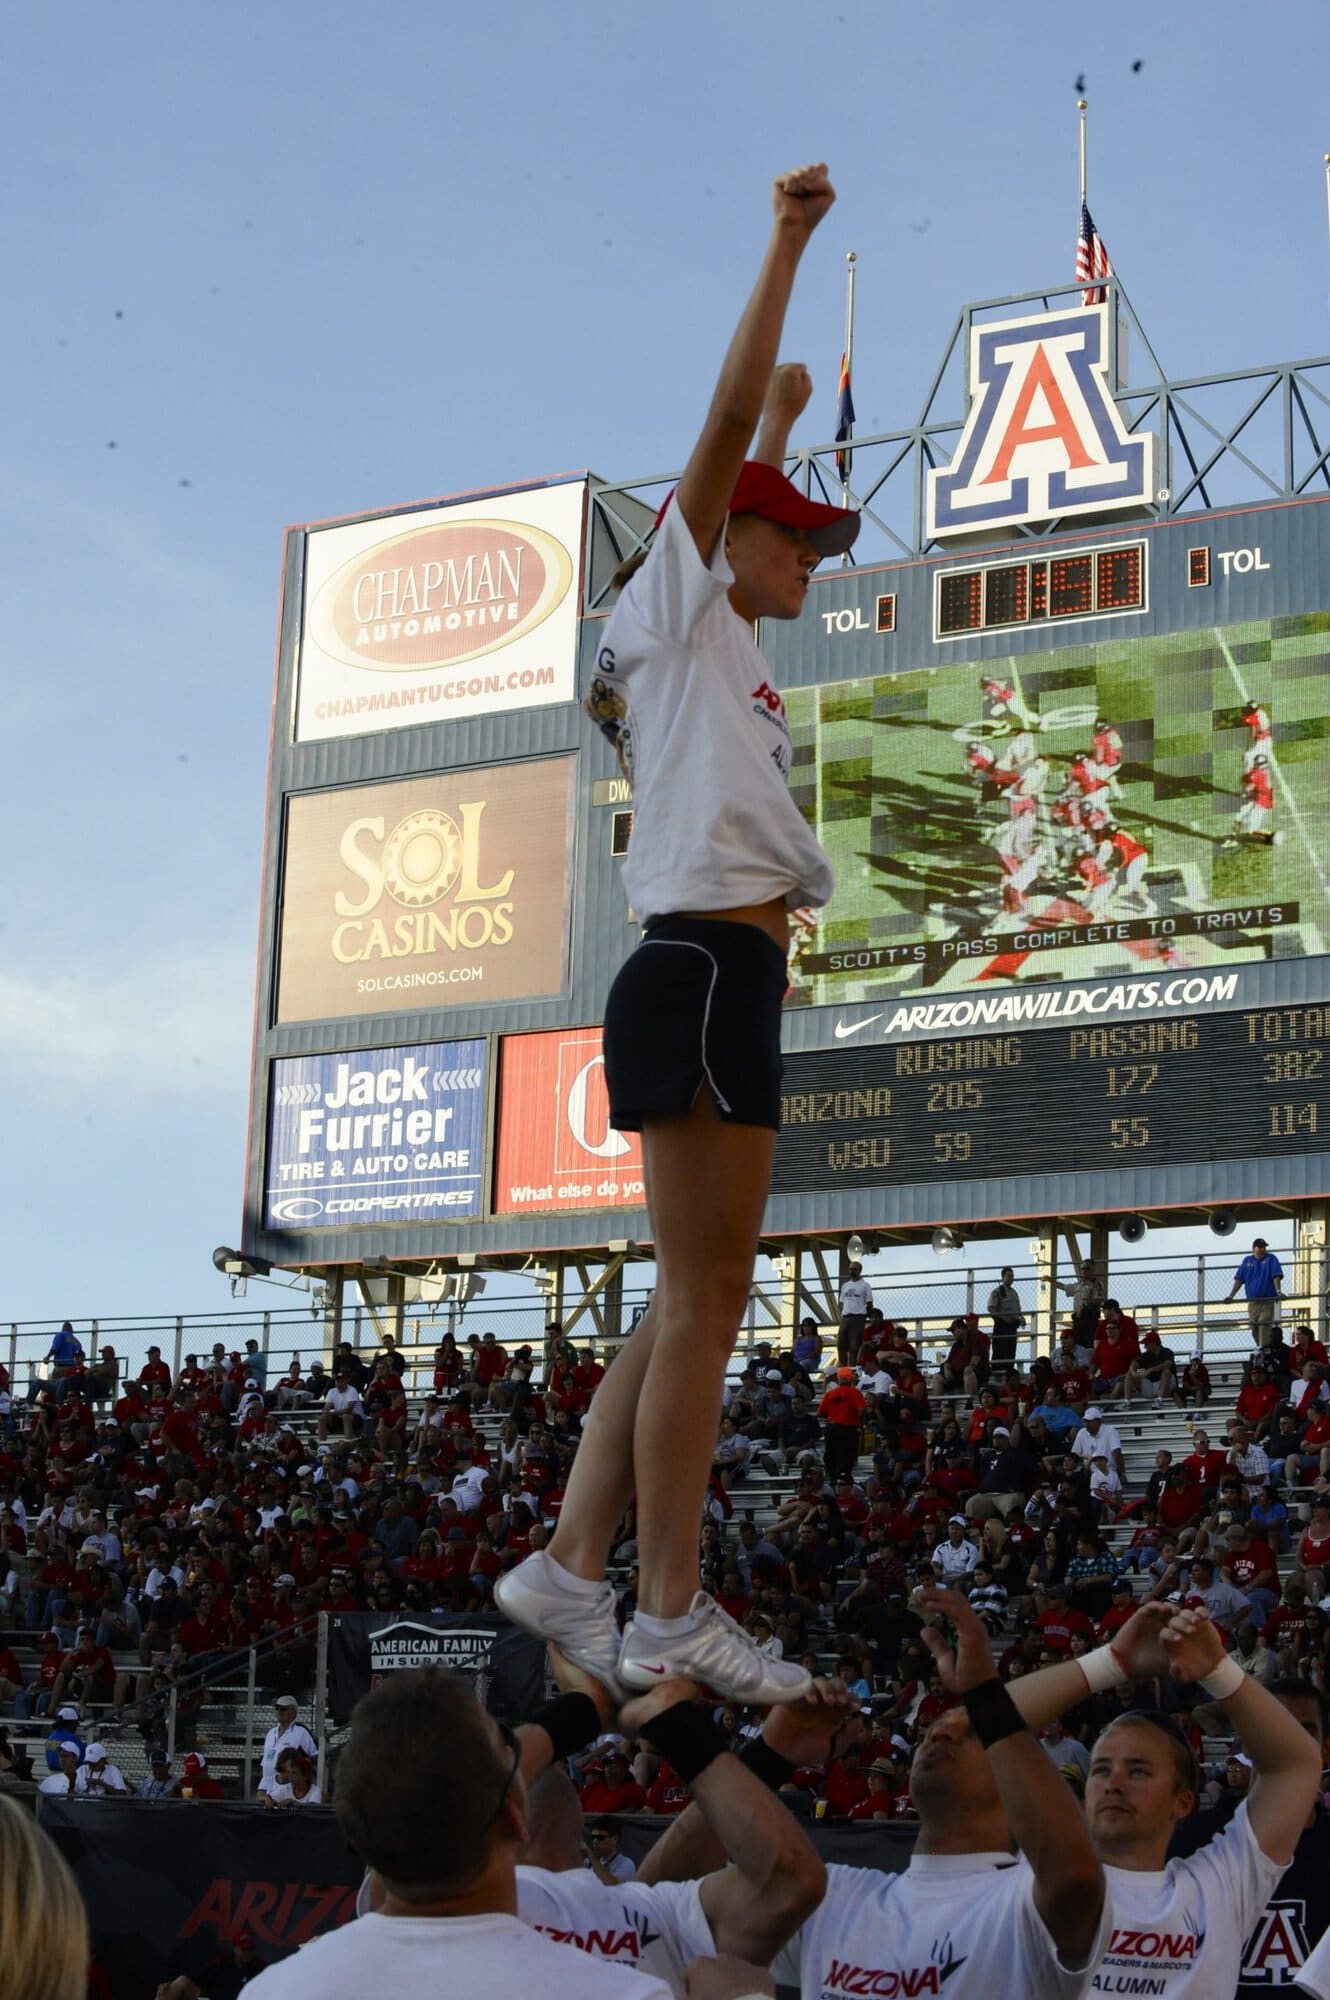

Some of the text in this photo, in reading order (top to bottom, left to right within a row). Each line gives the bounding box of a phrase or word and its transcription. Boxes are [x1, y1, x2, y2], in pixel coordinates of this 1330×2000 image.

[353, 547, 525, 624] CHAPMAN
[1217, 547, 1271, 575] TOL
[356, 602, 519, 646] AUTOMOTIVE
[822, 609, 869, 634] TOL
[315, 667, 555, 720] CHAPMANTUCSON.COM
[335, 801, 515, 917] SOL
[332, 901, 514, 964] CASINOS
[829, 906, 1283, 970] SCOTT'S PASS COMPLETE TO TRAVIS
[357, 966, 483, 993] SOLCASINOS.COM
[884, 974, 1239, 1034] ARIZONAWILDCATS.COM
[895, 1036, 1023, 1076] RUSHING
[1070, 1020, 1199, 1060] PASSING
[324, 1057, 430, 1109] Jack
[927, 1079, 984, 1112] 205
[1106, 1064, 1159, 1098] 177
[1263, 1049, 1323, 1082] 382
[299, 1103, 454, 1154] Furrier
[828, 1138, 890, 1170] WSU
[934, 1131, 972, 1162] 59
[1111, 1116, 1149, 1149] 55
[280, 1149, 469, 1181] TIRE & AUTO CARE
[510, 1185, 552, 1203] What
[558, 1182, 592, 1199] else
[597, 1180, 618, 1196] do
[371, 1639, 493, 1654] AMERICAN FAMILY
[1108, 1929, 1194, 1959] IZONA
